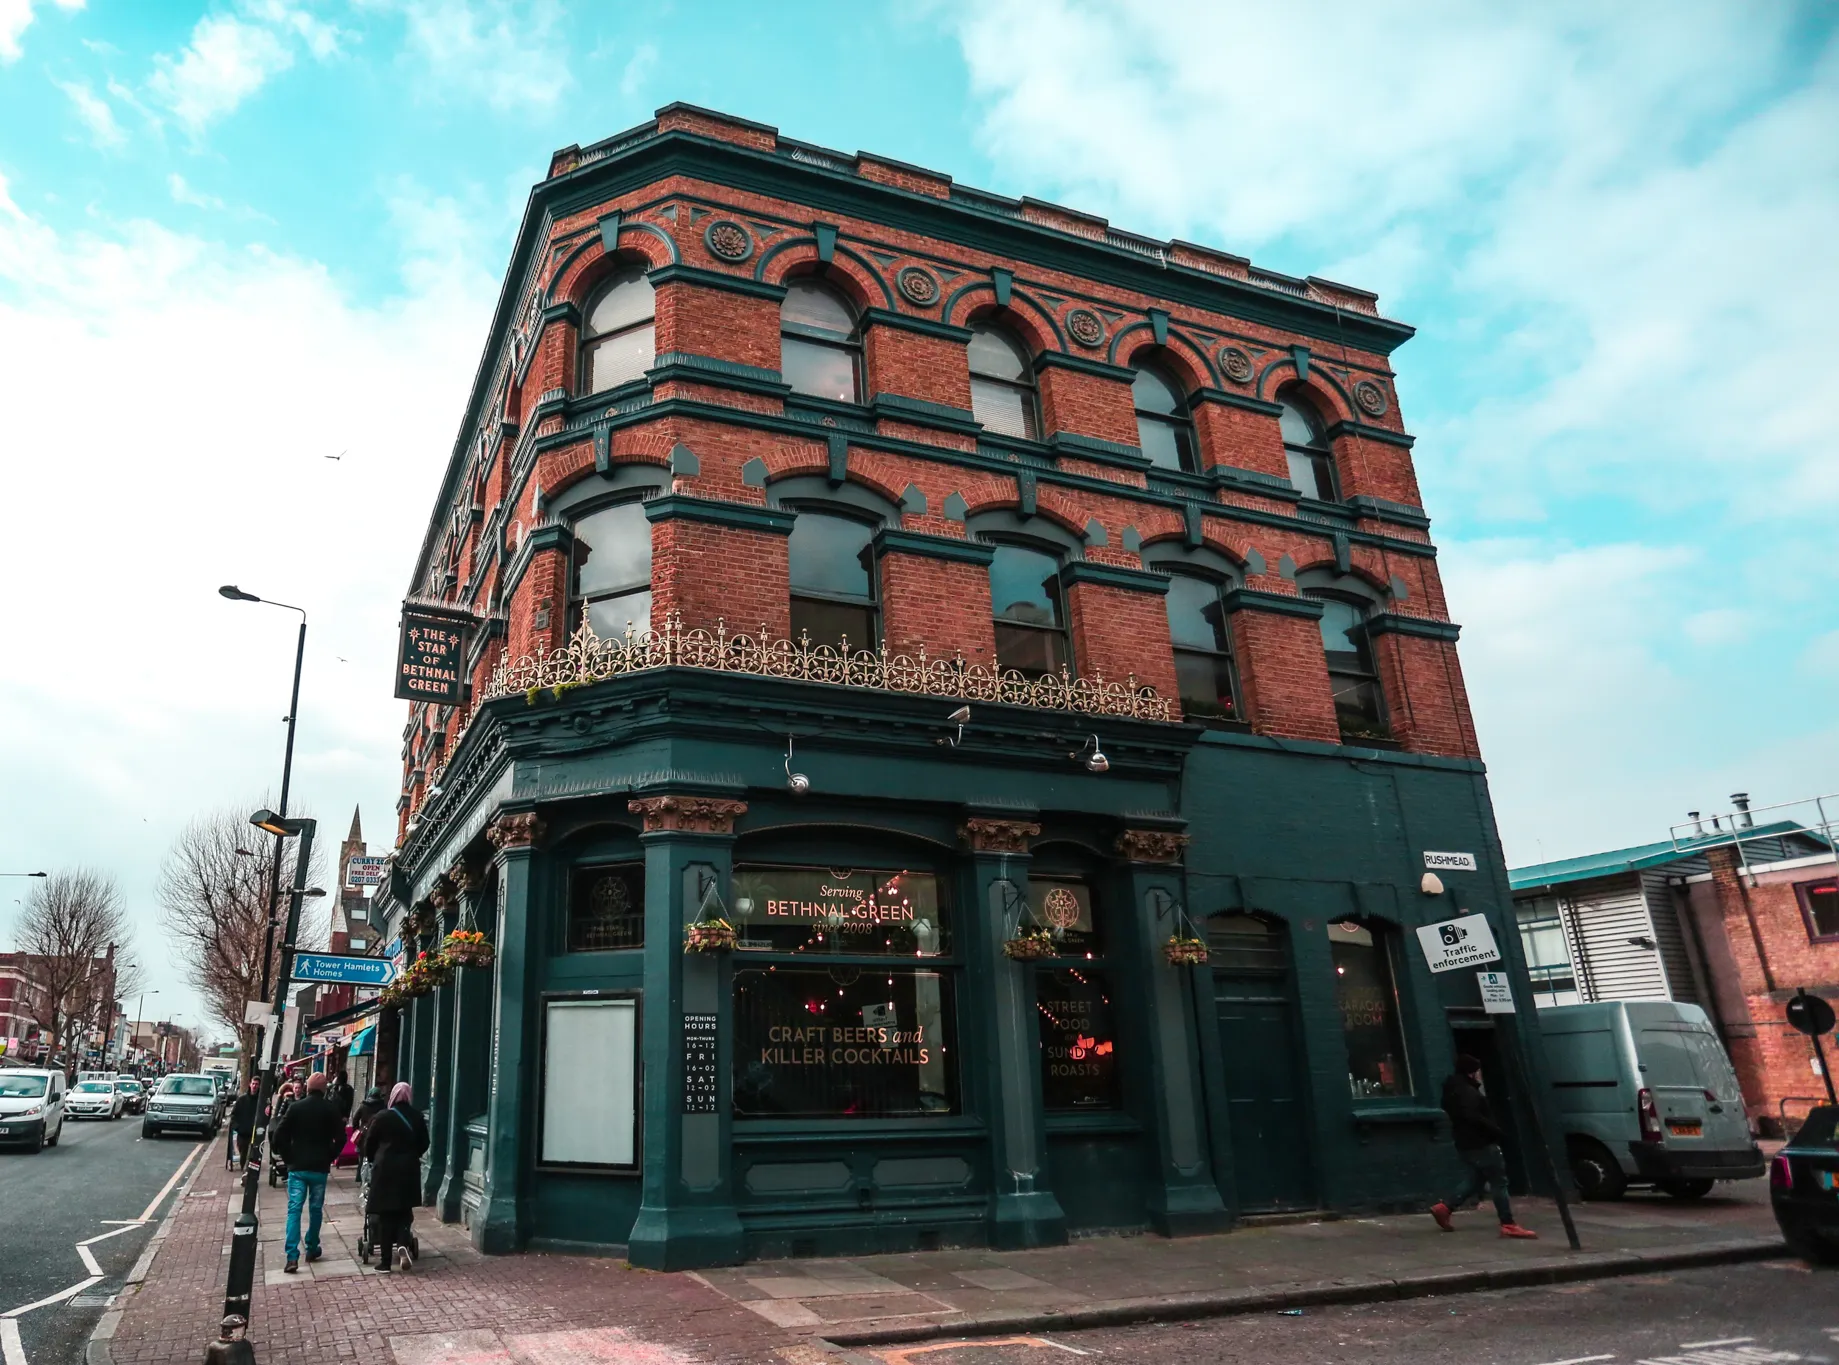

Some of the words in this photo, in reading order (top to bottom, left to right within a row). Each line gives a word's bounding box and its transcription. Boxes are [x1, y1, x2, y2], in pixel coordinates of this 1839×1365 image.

[422, 628, 447, 641] THE
[418, 641, 447, 656] STAR
[422, 656, 440, 666] OF
[402, 664, 457, 682] BETHNAL
[408, 679, 449, 694] GREEN
[1425, 855, 1470, 866] RUSHMEAD
[820, 885, 864, 902] Serving
[768, 900, 849, 918] BETHNAL
[856, 904, 914, 921] GREEN
[812, 922, 840, 934] since
[842, 922, 872, 935] 2008
[1443, 944, 1478, 958] Traffic
[315, 960, 341, 969] Tower
[344, 962, 380, 972] Hamlets
[1432, 949, 1496, 970] enforcement
[313, 969, 343, 978] Homes
[1047, 1001, 1092, 1013] STREET
[1346, 1014, 1383, 1027] ROOM
[768, 1026, 824, 1043] CRAFT
[833, 1027, 887, 1043] BEERS
[893, 1026, 924, 1044] and
[762, 1048, 826, 1065] KILLER
[832, 1048, 929, 1065] COCKTAILS
[1048, 1045, 1100, 1059] SUND
[1051, 1064, 1100, 1076] ROASTS
